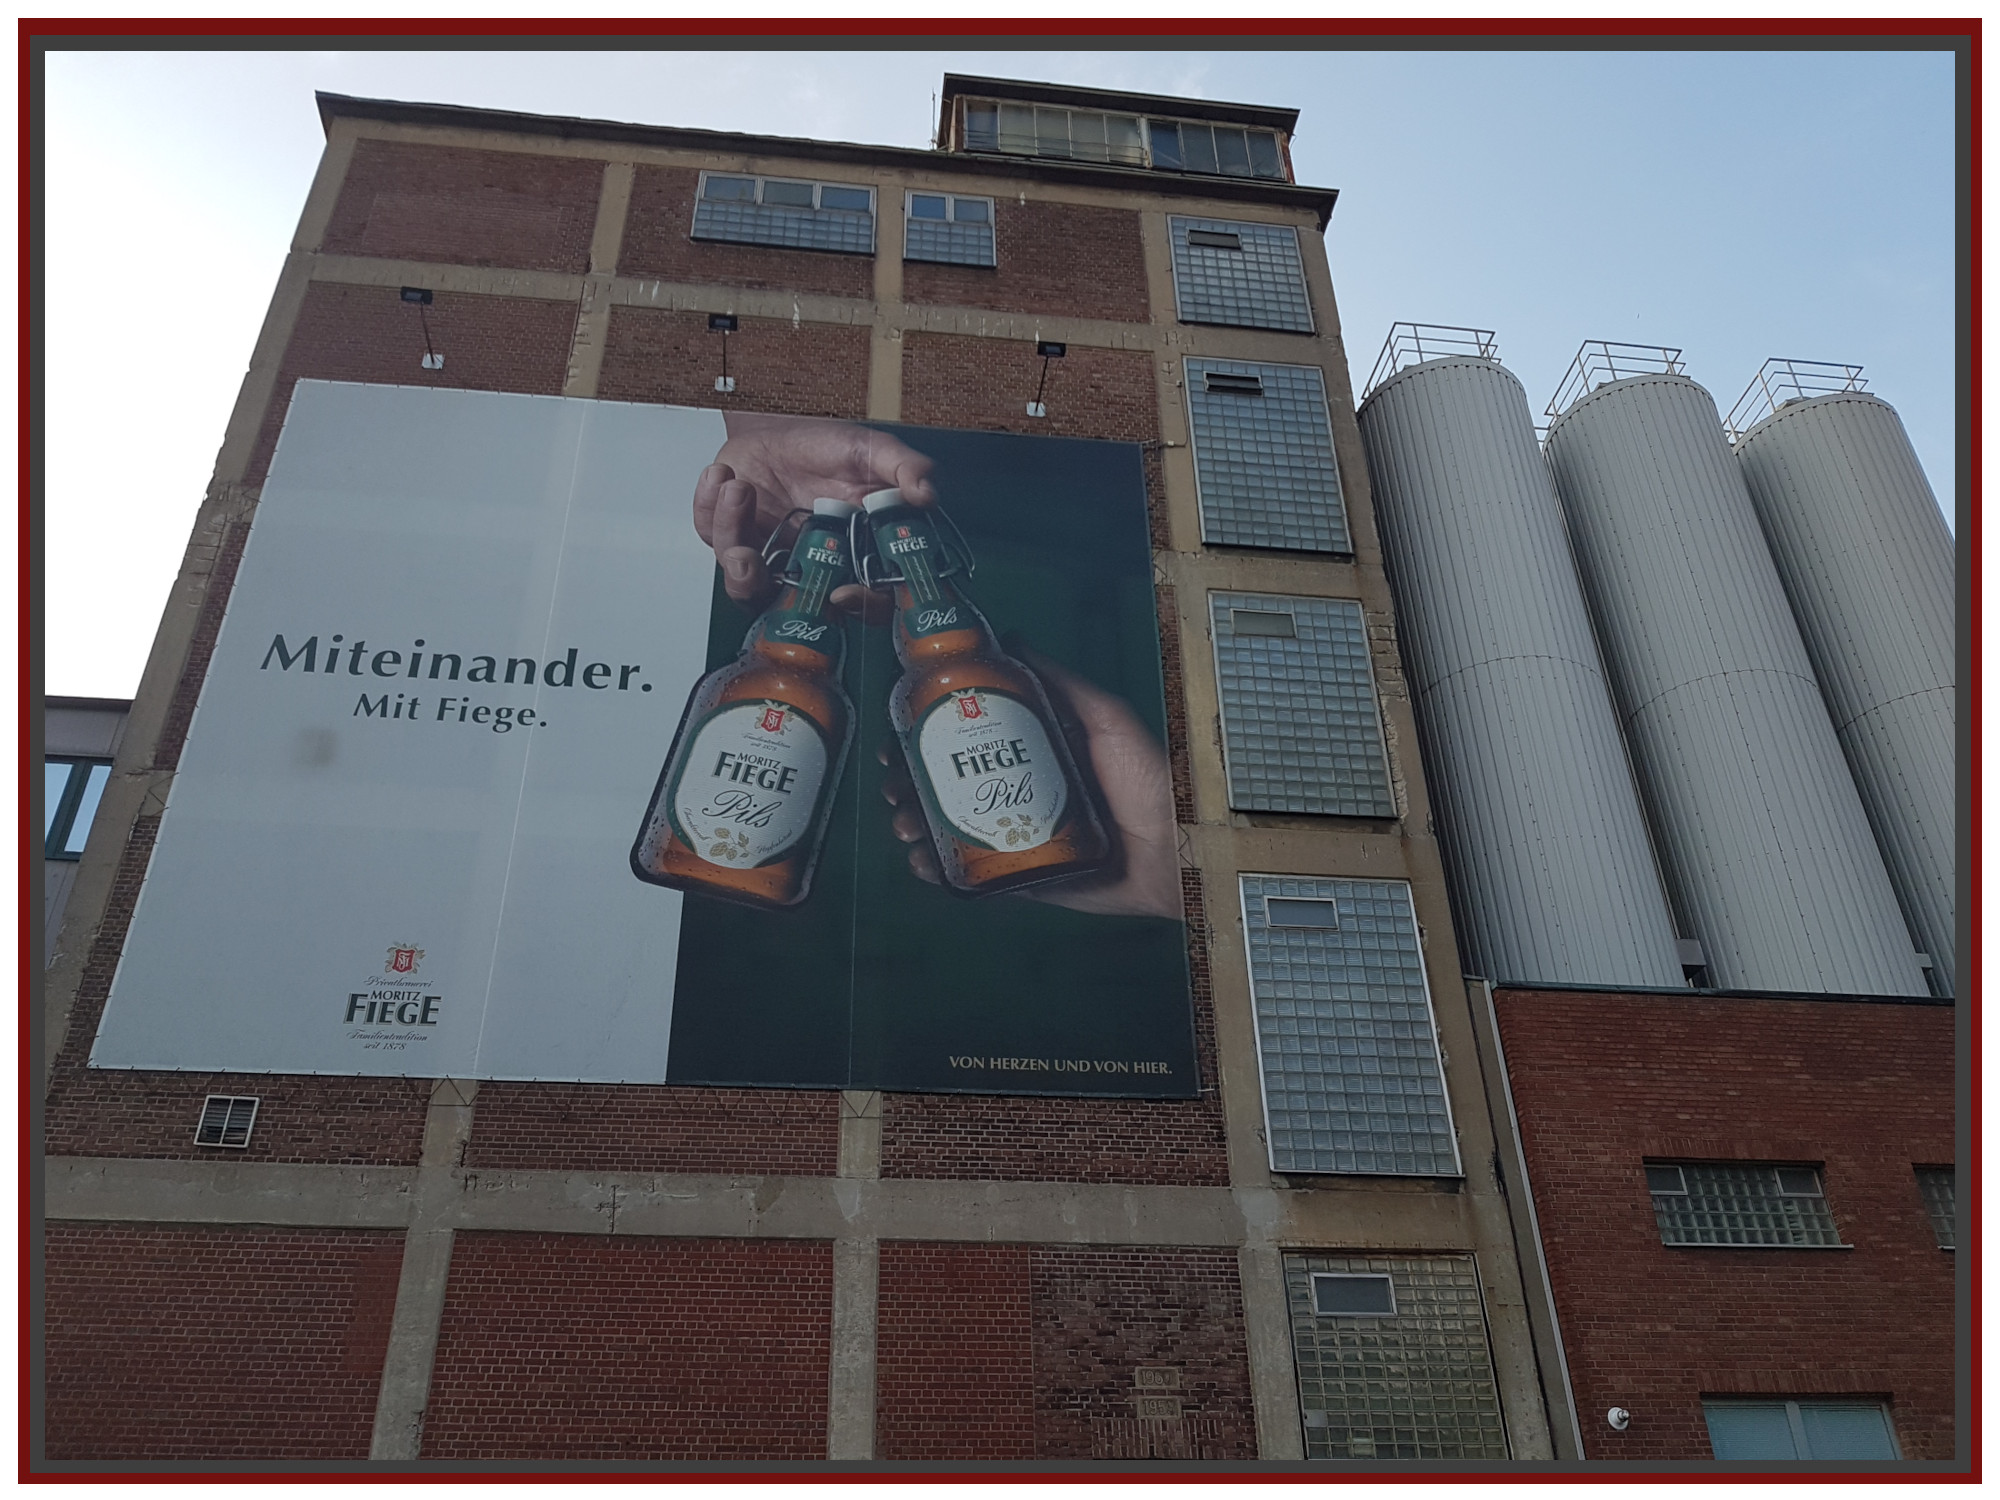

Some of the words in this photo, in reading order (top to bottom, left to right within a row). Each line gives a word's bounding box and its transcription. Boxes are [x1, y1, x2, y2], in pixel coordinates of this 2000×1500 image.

[889, 536, 928, 555] FIEGE
[807, 547, 846, 567] FIEGE
[917, 606, 958, 632] Pils
[775, 620, 827, 641] Pils
[260, 634, 653, 693] Miteinander.
[353, 692, 421, 721] Mit
[436, 696, 547, 734] Fiege.
[966, 739, 1007, 757] MORITZ
[738, 752, 781, 770] MORITZ
[950, 738, 1031, 780] FIEGE
[711, 750, 798, 794] FIEGE
[973, 771, 1034, 815] Pils
[701, 789, 783, 828] Pils
[363, 975, 434, 988] Privatbrauerei
[370, 990, 422, 1002] MORITZ
[342, 992, 442, 1027] FIEGE
[346, 1028, 428, 1042] Familientradition
[364, 1041, 381, 1050] seit
[382, 1042, 407, 1051] 1878
[949, 1055, 985, 1069] VON
[990, 1057, 1049, 1071] HERZEN
[1054, 1059, 1090, 1072] UND
[1094, 1060, 1129, 1073] VON
[1133, 1061, 1173, 1075] HIER.
